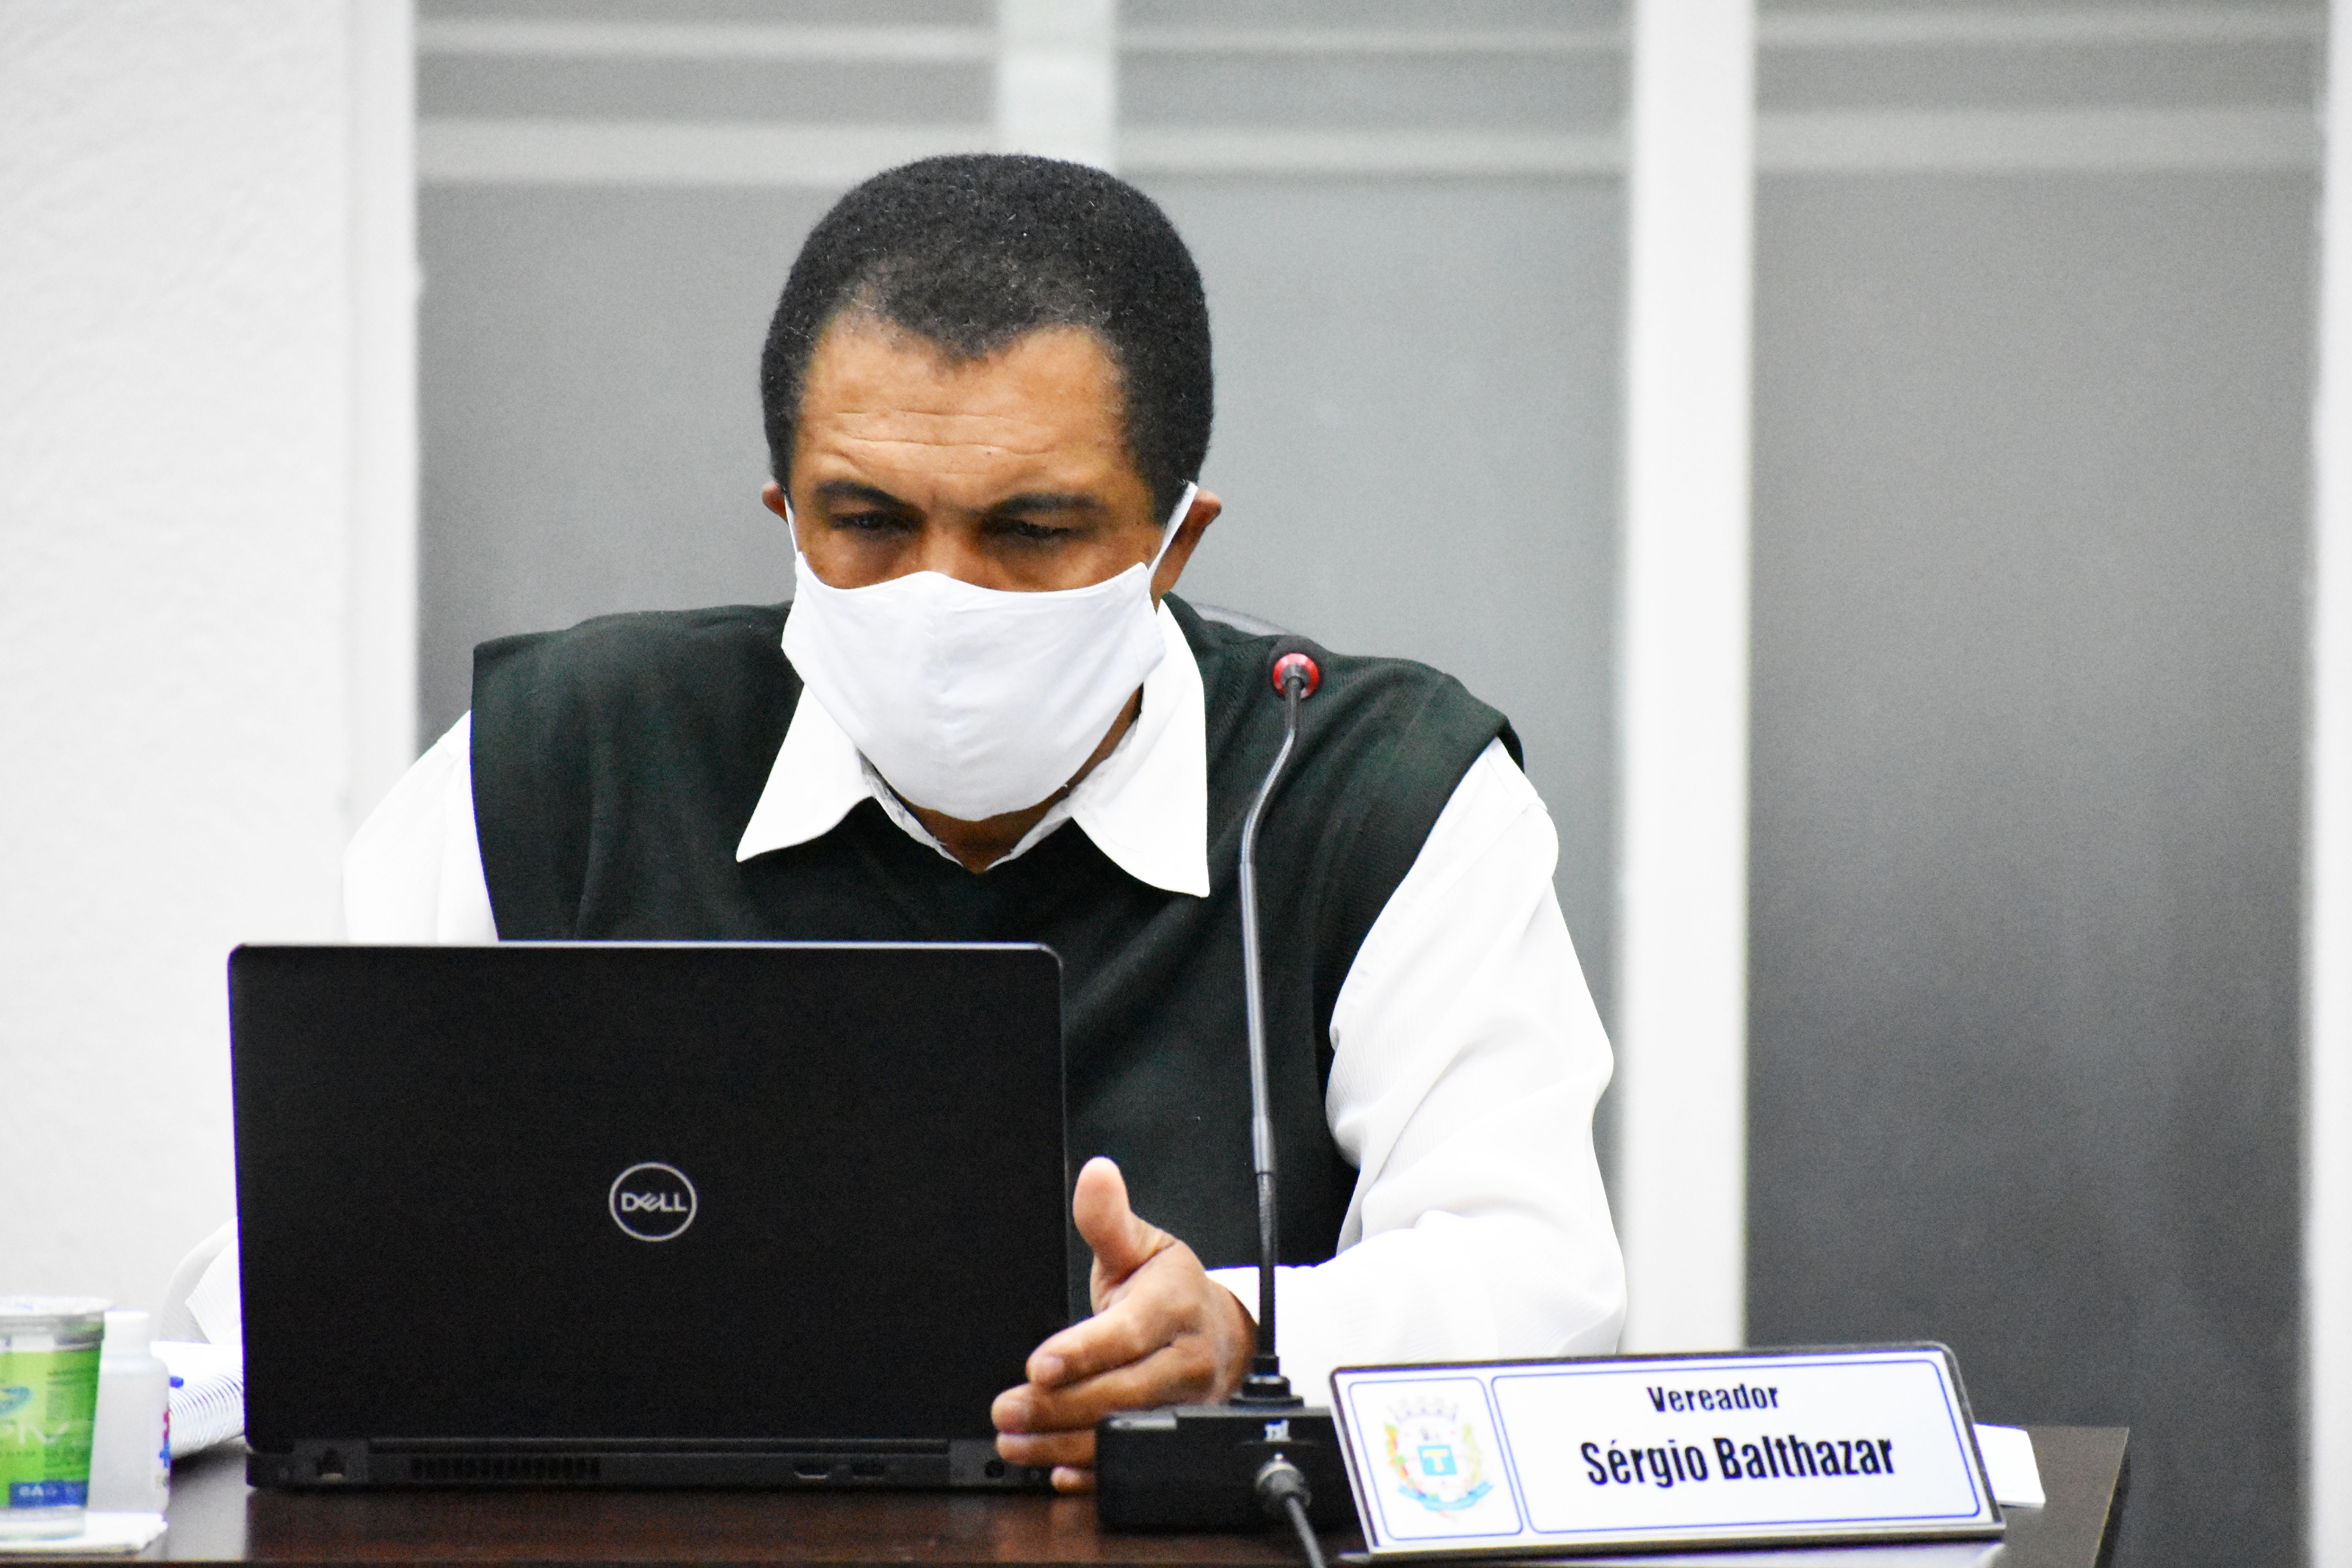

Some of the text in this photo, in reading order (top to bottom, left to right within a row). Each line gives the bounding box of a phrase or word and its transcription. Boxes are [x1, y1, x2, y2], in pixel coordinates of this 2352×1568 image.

[621, 1192, 687, 1212] DELL
[1646, 1383, 1779, 1412] Vereador
[1580, 1434, 1895, 1488] Sérgio Balthazar
